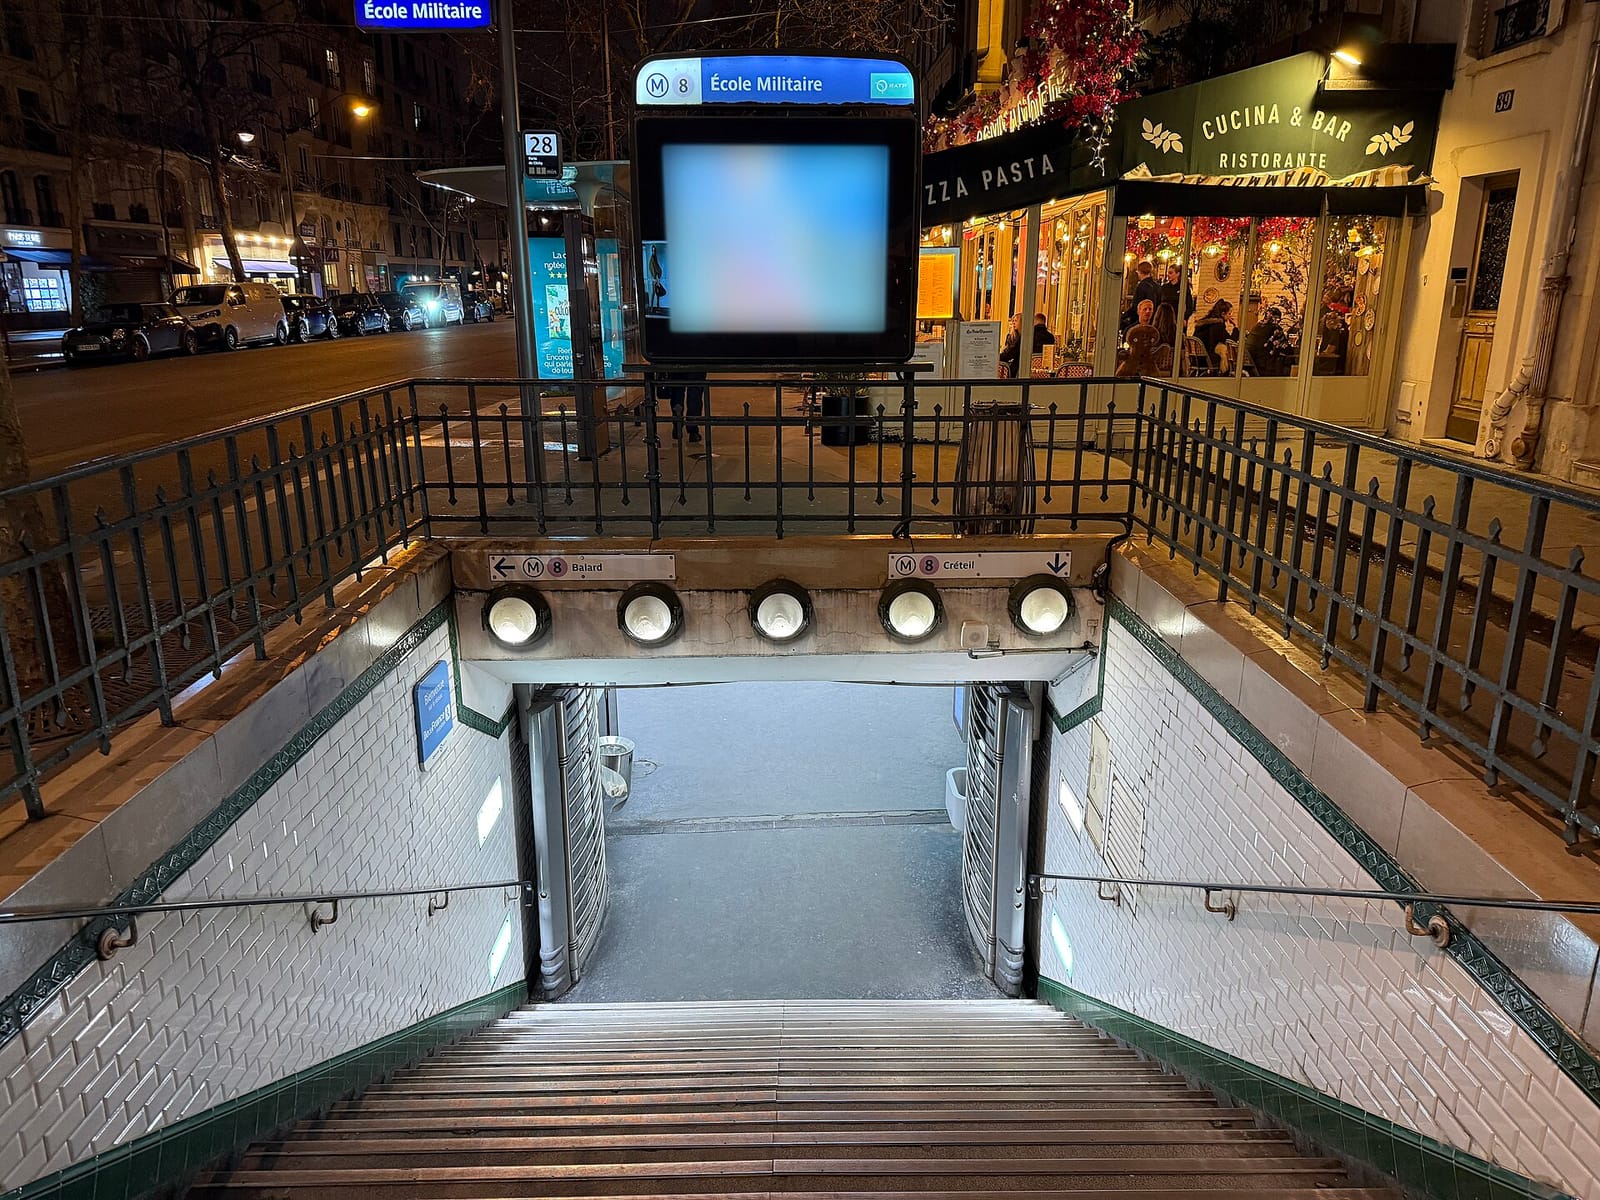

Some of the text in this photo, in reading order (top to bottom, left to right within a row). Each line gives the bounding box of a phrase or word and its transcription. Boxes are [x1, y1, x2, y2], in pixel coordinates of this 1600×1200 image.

[364, 0, 482, 19] École Militaire
[678, 79, 688, 93] 8
[710, 74, 751, 92] École
[757, 76, 822, 92] Militaire
[1496, 91, 1511, 110] 39
[1202, 103, 1353, 143] CUCINA & BAR
[529, 136, 553, 154] 28
[1219, 152, 1327, 169] RISTORANTE
[925, 154, 1054, 205] ZZA PASTA
[553, 562, 562, 573] 8
[572, 562, 603, 572] Balard
[924, 559, 934, 571] 8
[943, 560, 975, 570] Créteil
